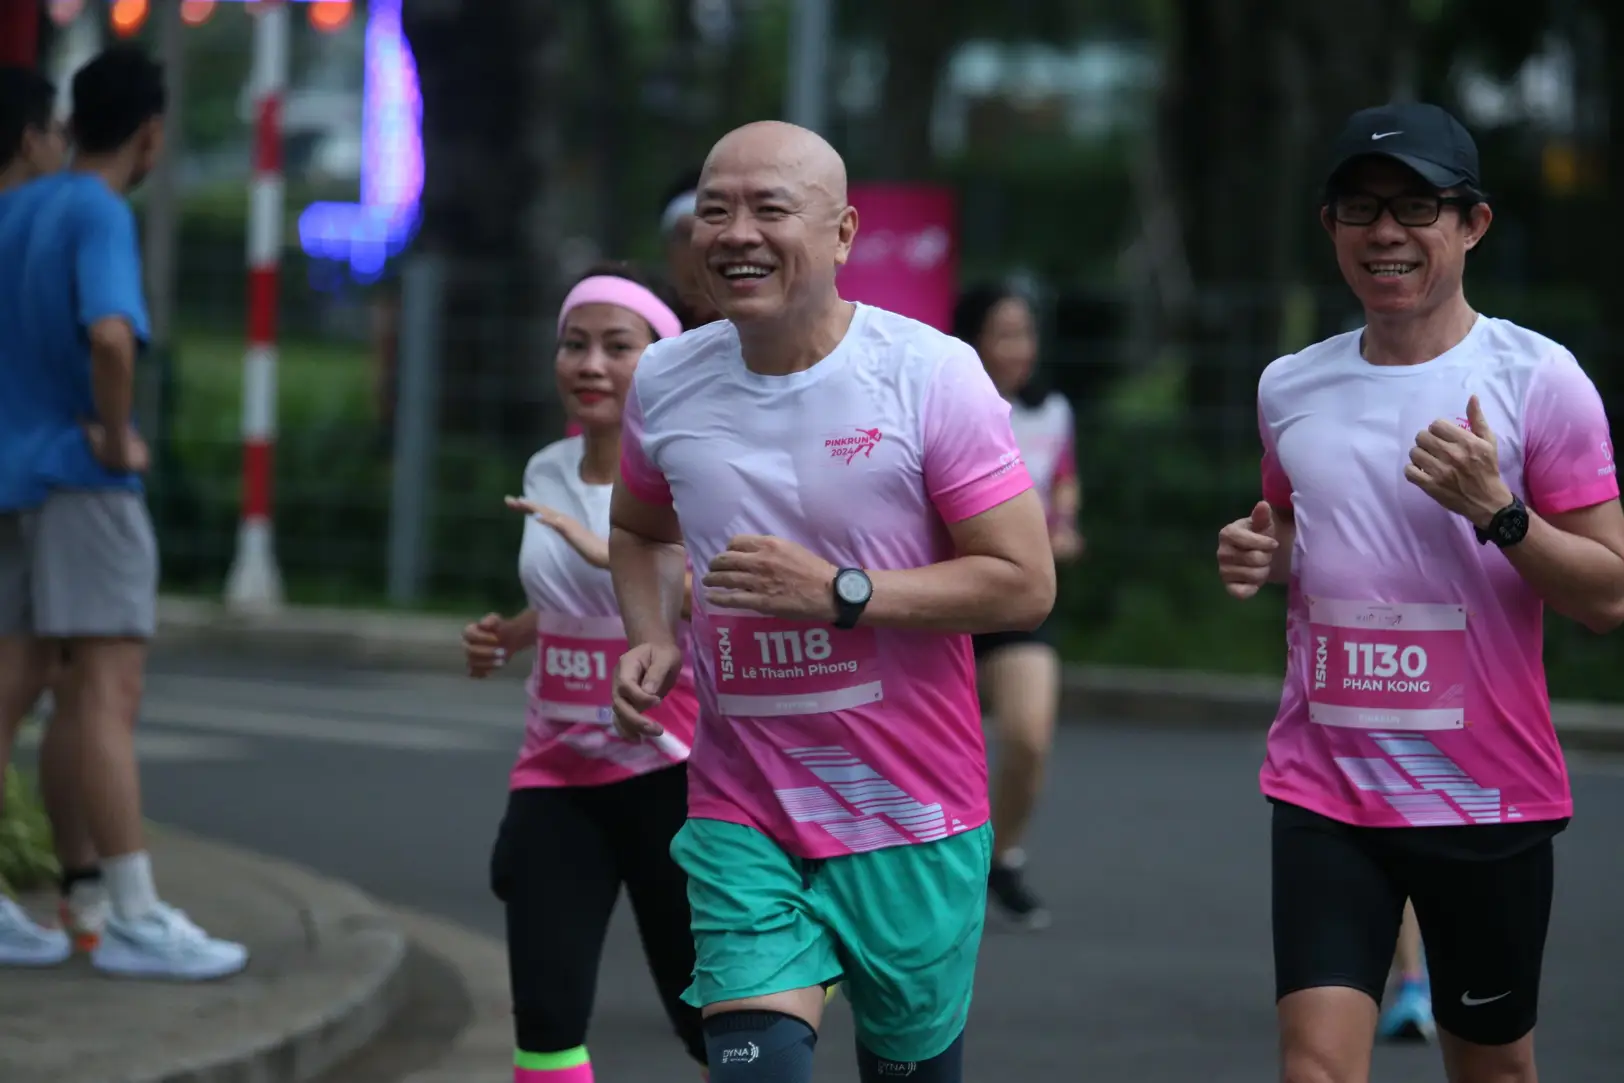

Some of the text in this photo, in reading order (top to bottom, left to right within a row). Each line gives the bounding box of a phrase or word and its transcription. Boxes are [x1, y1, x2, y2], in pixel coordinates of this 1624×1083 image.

[825, 437, 869, 447] PINKRUN
[831, 448, 855, 457] 2024
[717, 627, 735, 681] 15KM
[754, 628, 832, 664] 1118
[1344, 641, 1427, 678] 1130
[545, 647, 607, 680] 8381
[742, 660, 857, 679] Lê Thanh Phong
[1315, 636, 1328, 690] 15KM
[1343, 679, 1430, 693] PHAN KONG
